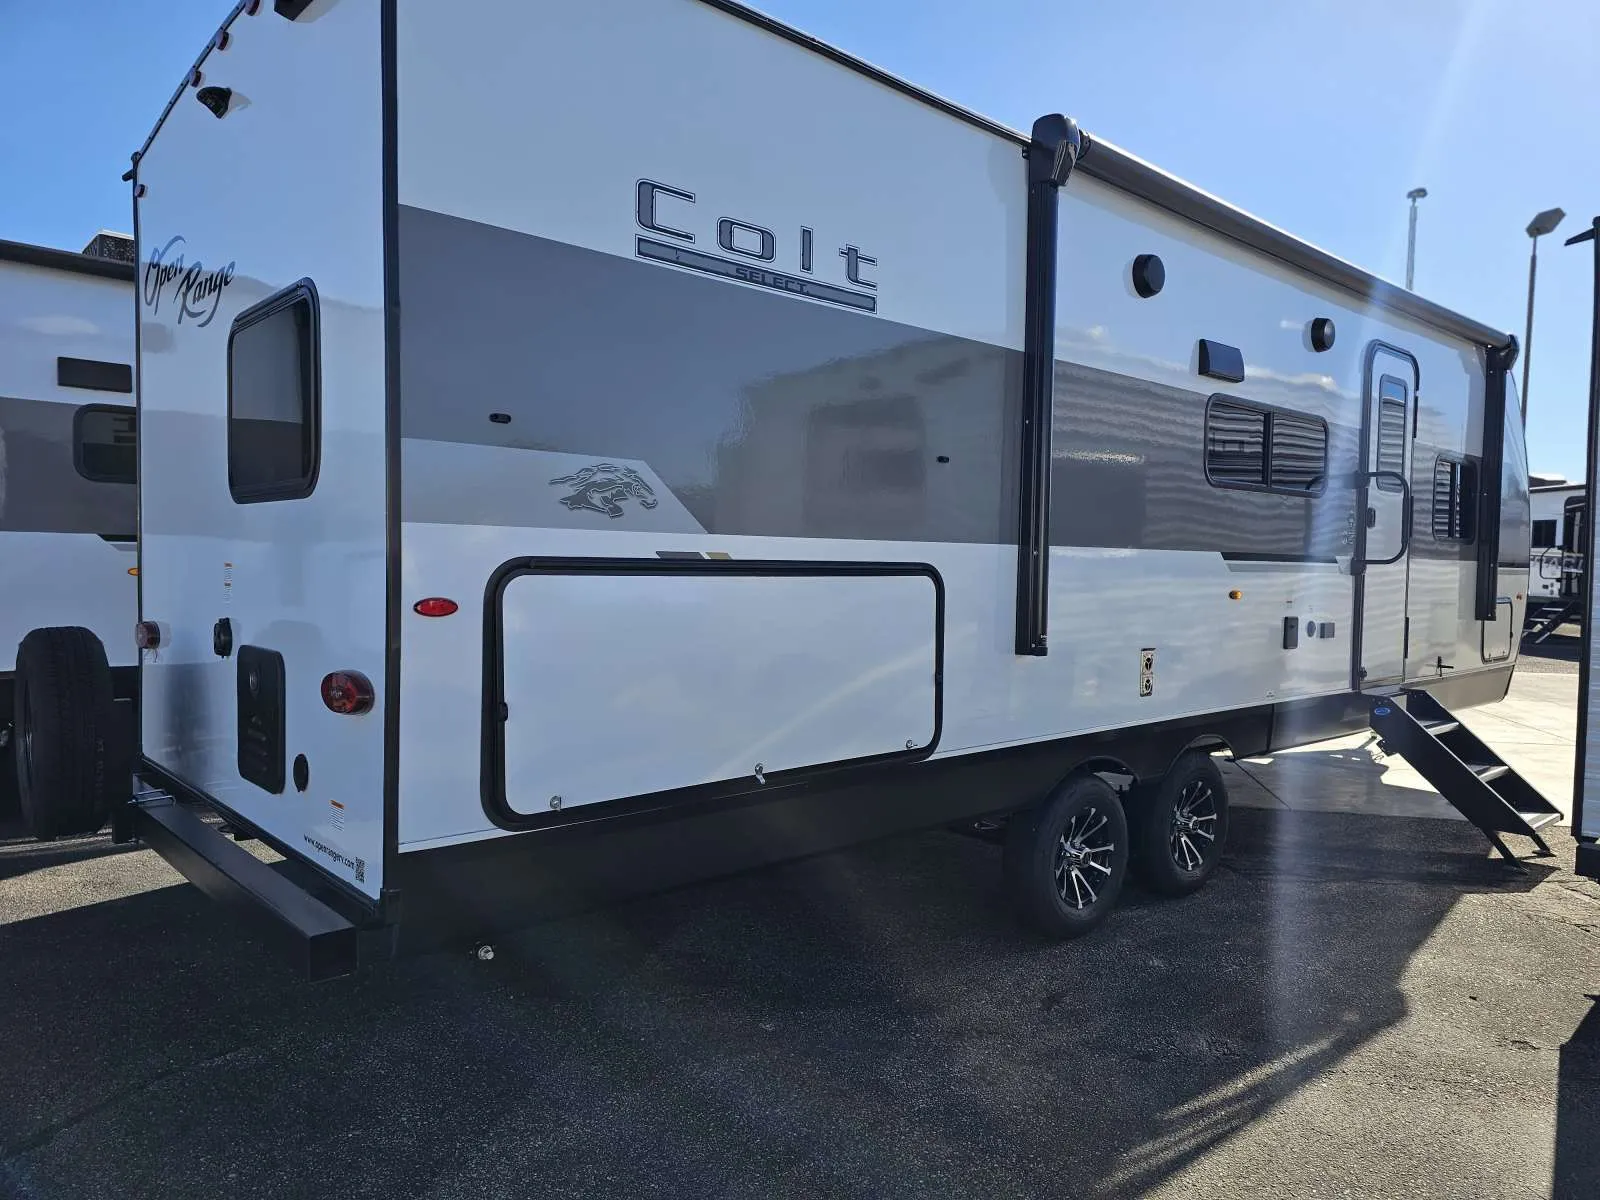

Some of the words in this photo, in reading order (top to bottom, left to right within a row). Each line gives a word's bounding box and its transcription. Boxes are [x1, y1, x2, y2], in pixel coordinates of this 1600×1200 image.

[635, 178, 877, 291] Colt
[735, 267, 808, 295] SELECT
[144, 235, 186, 317] Open
[173, 260, 236, 328] Range
